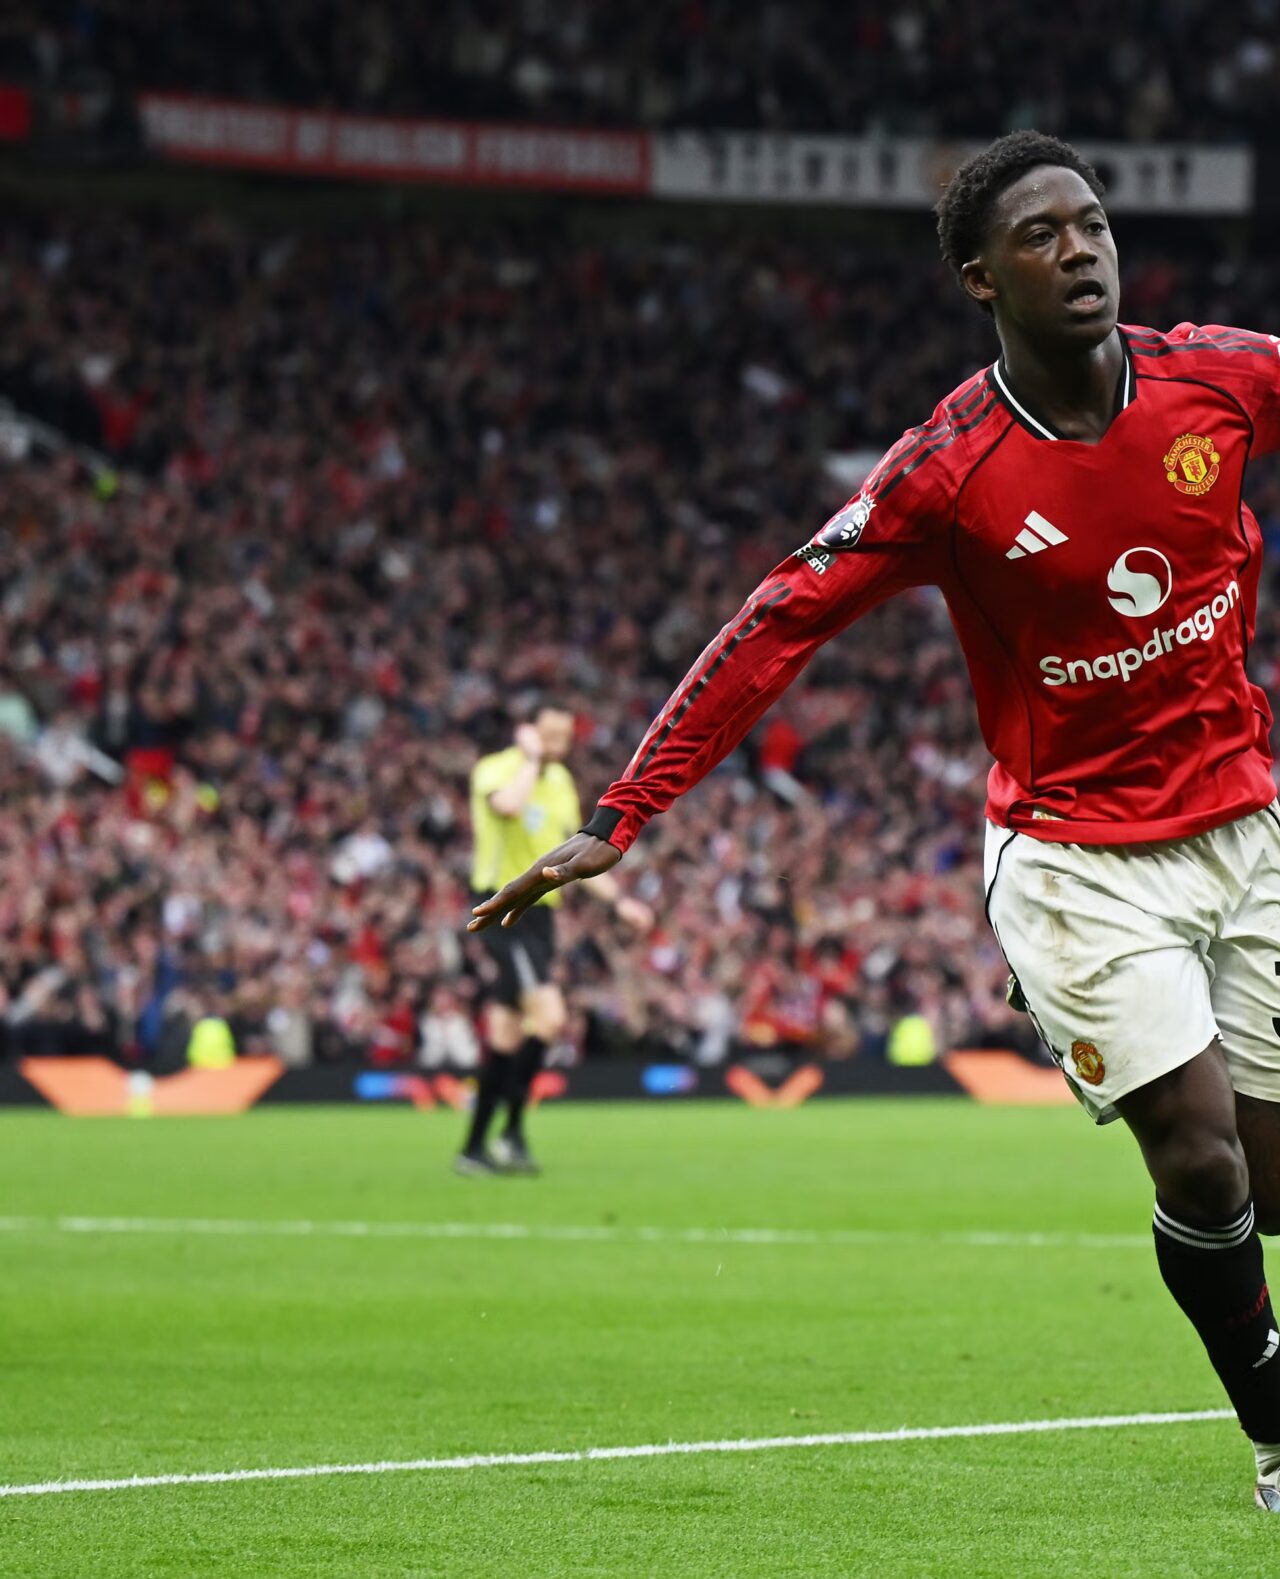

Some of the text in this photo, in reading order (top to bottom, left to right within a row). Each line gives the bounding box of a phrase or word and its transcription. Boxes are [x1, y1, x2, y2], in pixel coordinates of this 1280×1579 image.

[1168, 437, 1211, 466] MANCHESTER
[1185, 474, 1215, 492] UNITED
[1039, 579, 1241, 686] Snapdragon
